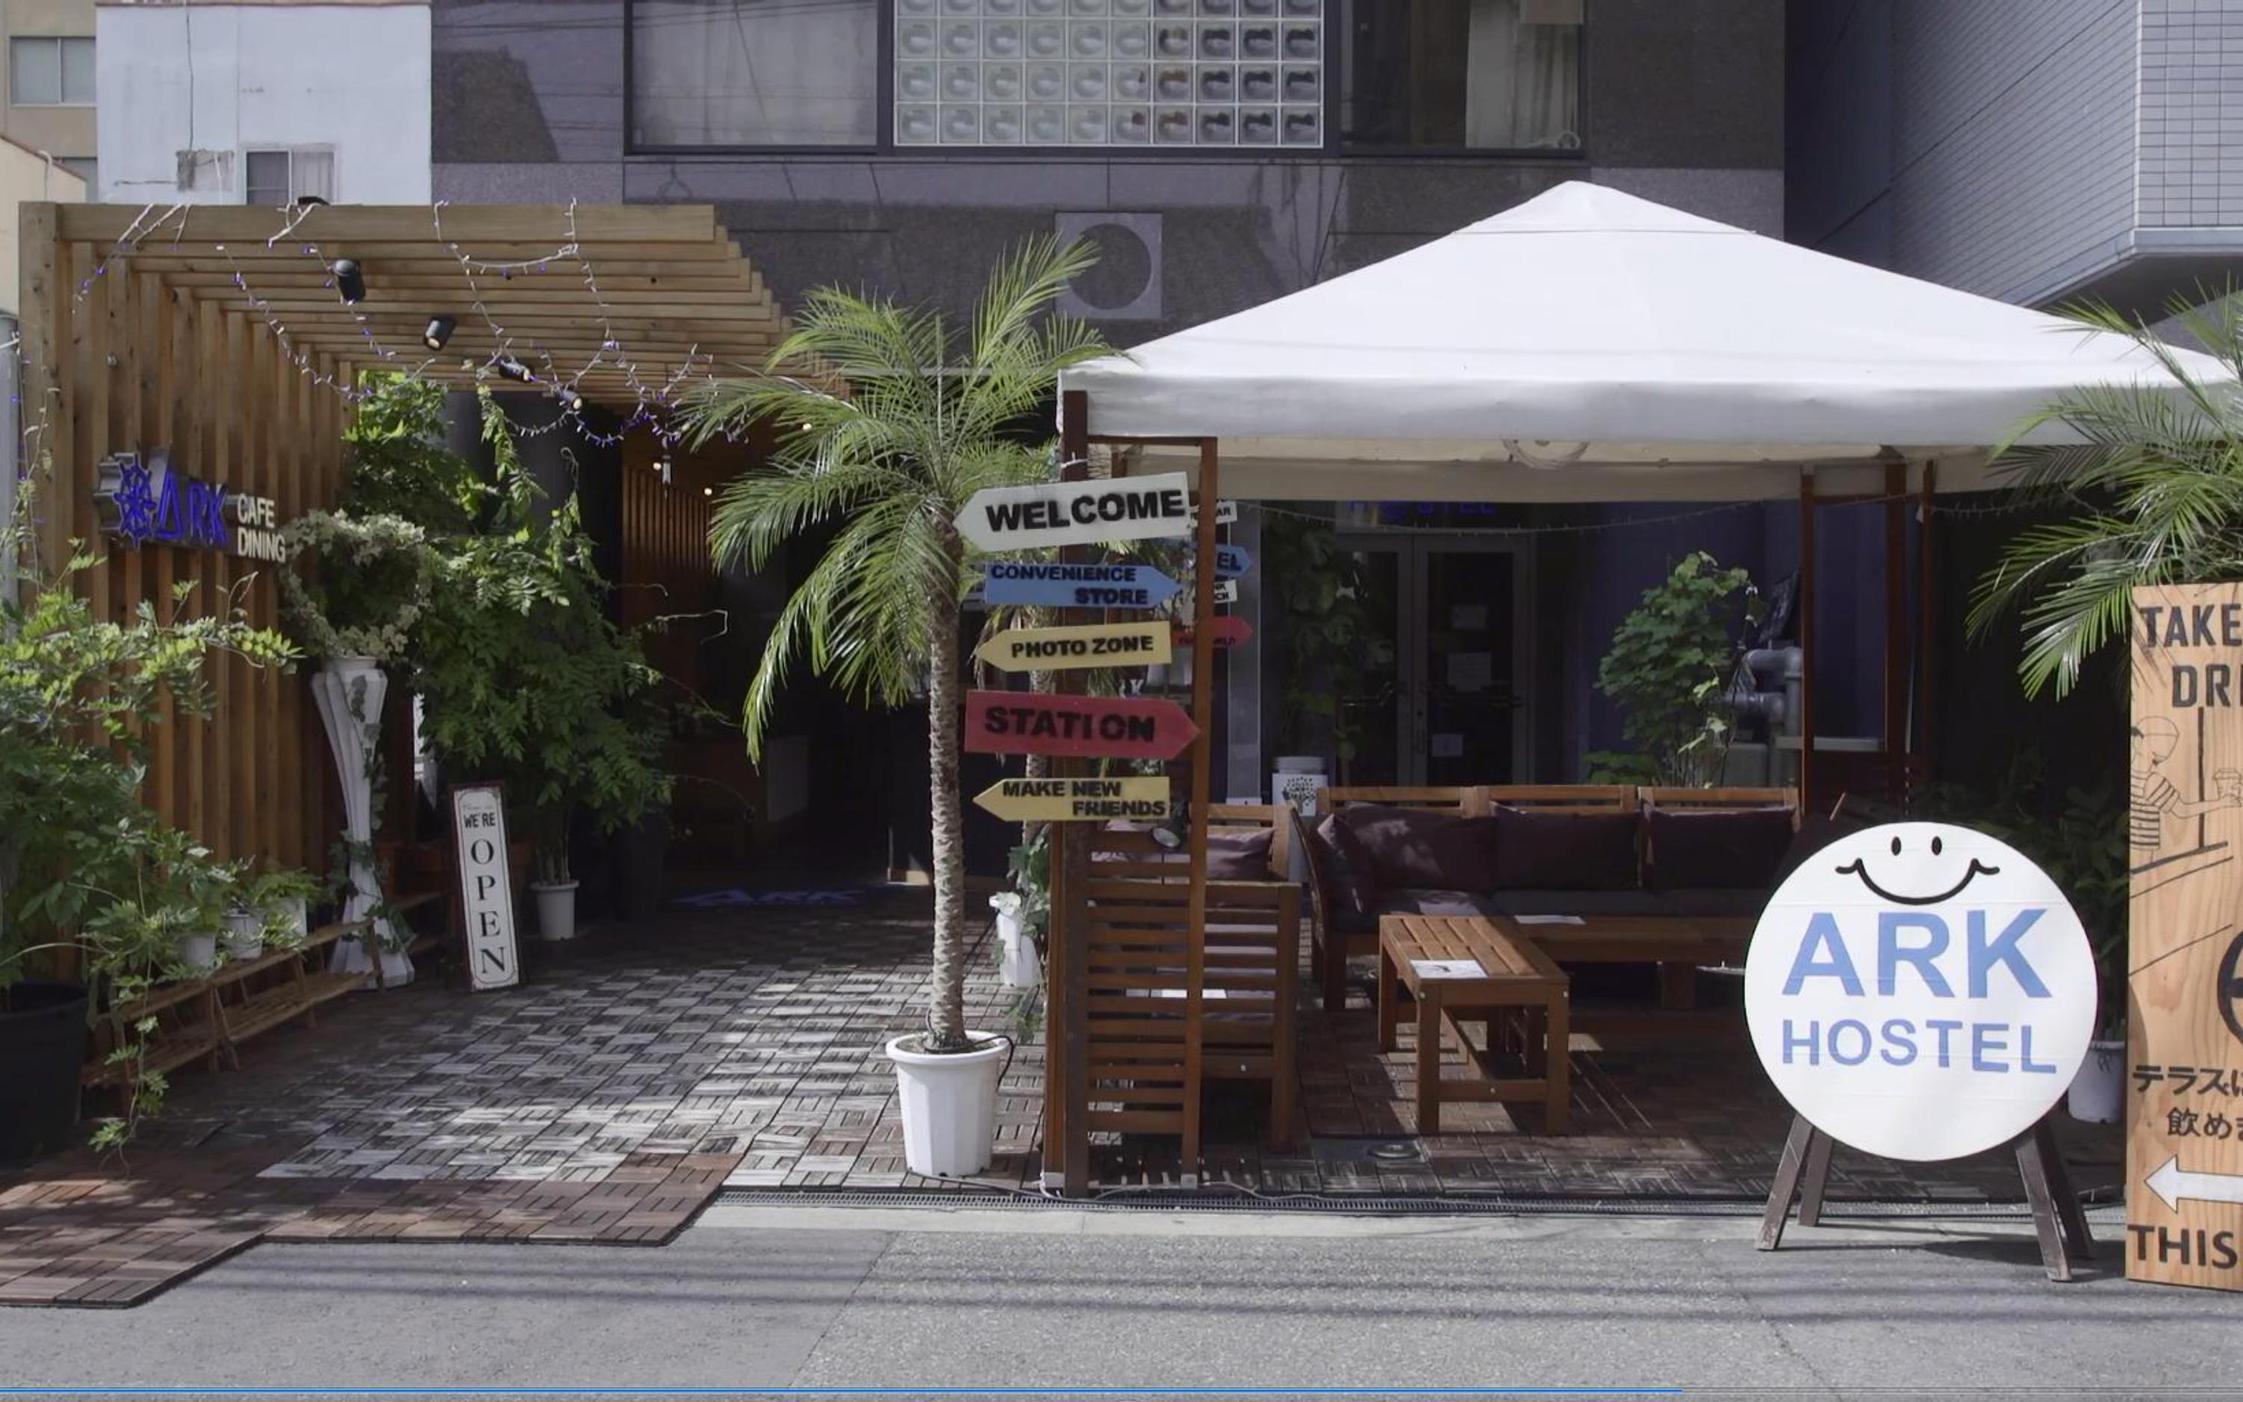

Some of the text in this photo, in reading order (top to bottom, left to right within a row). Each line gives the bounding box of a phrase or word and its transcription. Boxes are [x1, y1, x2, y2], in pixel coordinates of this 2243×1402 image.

[157, 468, 230, 546] ARK
[237, 493, 275, 529] CAFE
[985, 490, 1186, 532] WELCOME
[237, 527, 287, 564] DINING
[1216, 552, 1242, 572] EL
[991, 565, 1137, 582] CONVENIENCE
[1074, 587, 1149, 605] STORE
[2139, 603, 2243, 648] TAKE
[1011, 639, 1088, 658] PHOTO
[1092, 635, 1154, 655] ZONE
[984, 705, 1155, 743] STATION
[1002, 780, 1121, 797] MAKE NEW
[463, 811, 496, 829] WE'RE
[1072, 800, 1166, 817] FRIENDS
[470, 838, 507, 975] OPEN
[1782, 908, 2053, 999] ARK
[1782, 1018, 2058, 1074] HOSTEL
[2127, 1224, 2238, 1270] THIS
